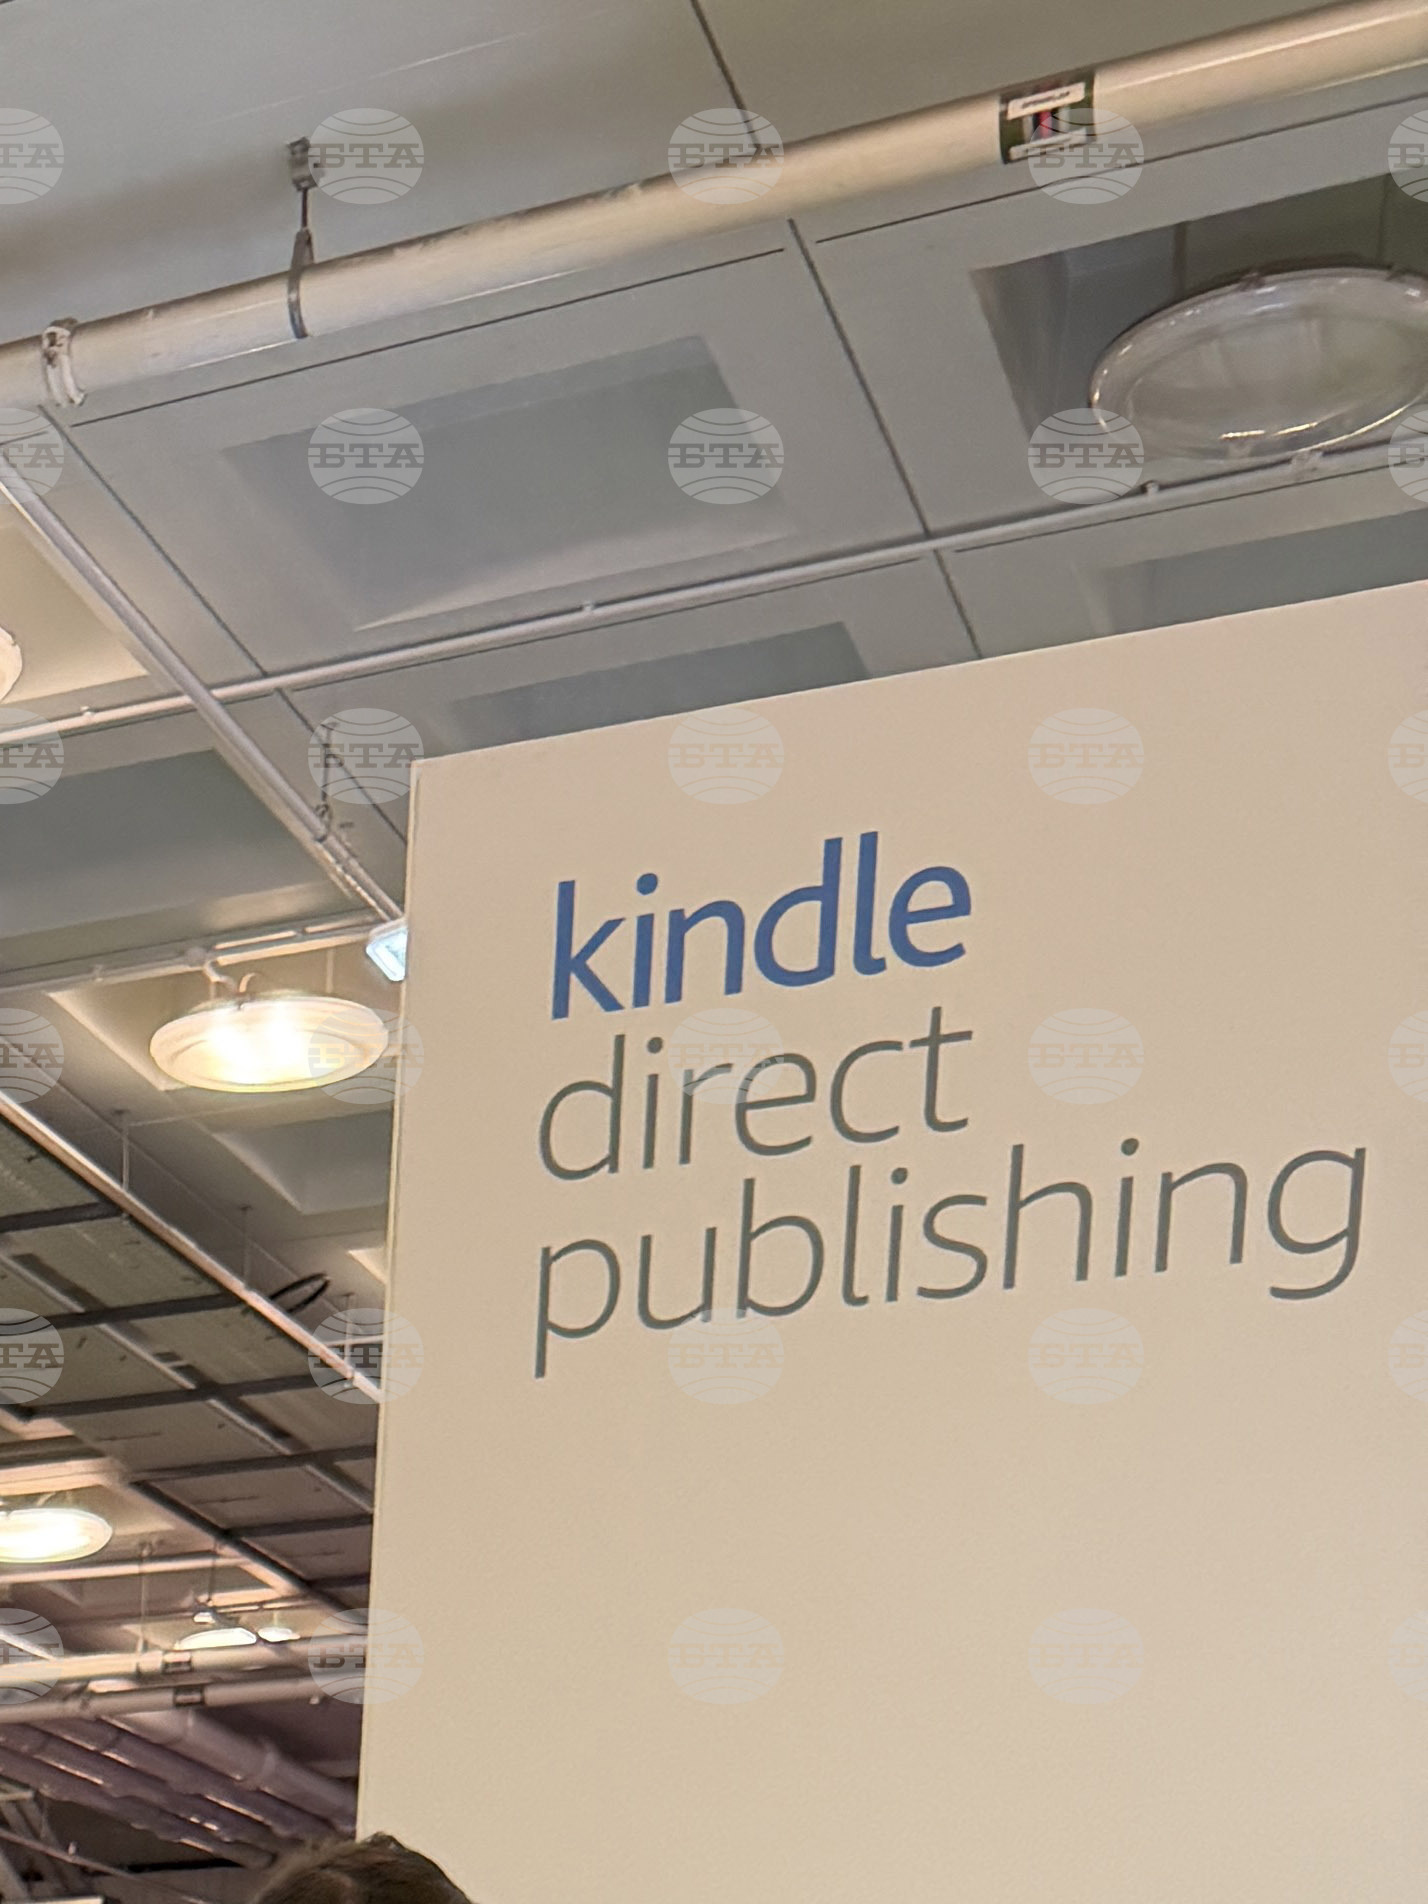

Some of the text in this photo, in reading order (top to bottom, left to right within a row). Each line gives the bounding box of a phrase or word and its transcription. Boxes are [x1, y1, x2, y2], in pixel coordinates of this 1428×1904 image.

[551, 830, 973, 1021] kindle
[538, 1005, 974, 1181] direct
[534, 1136, 1367, 1379] publishing
